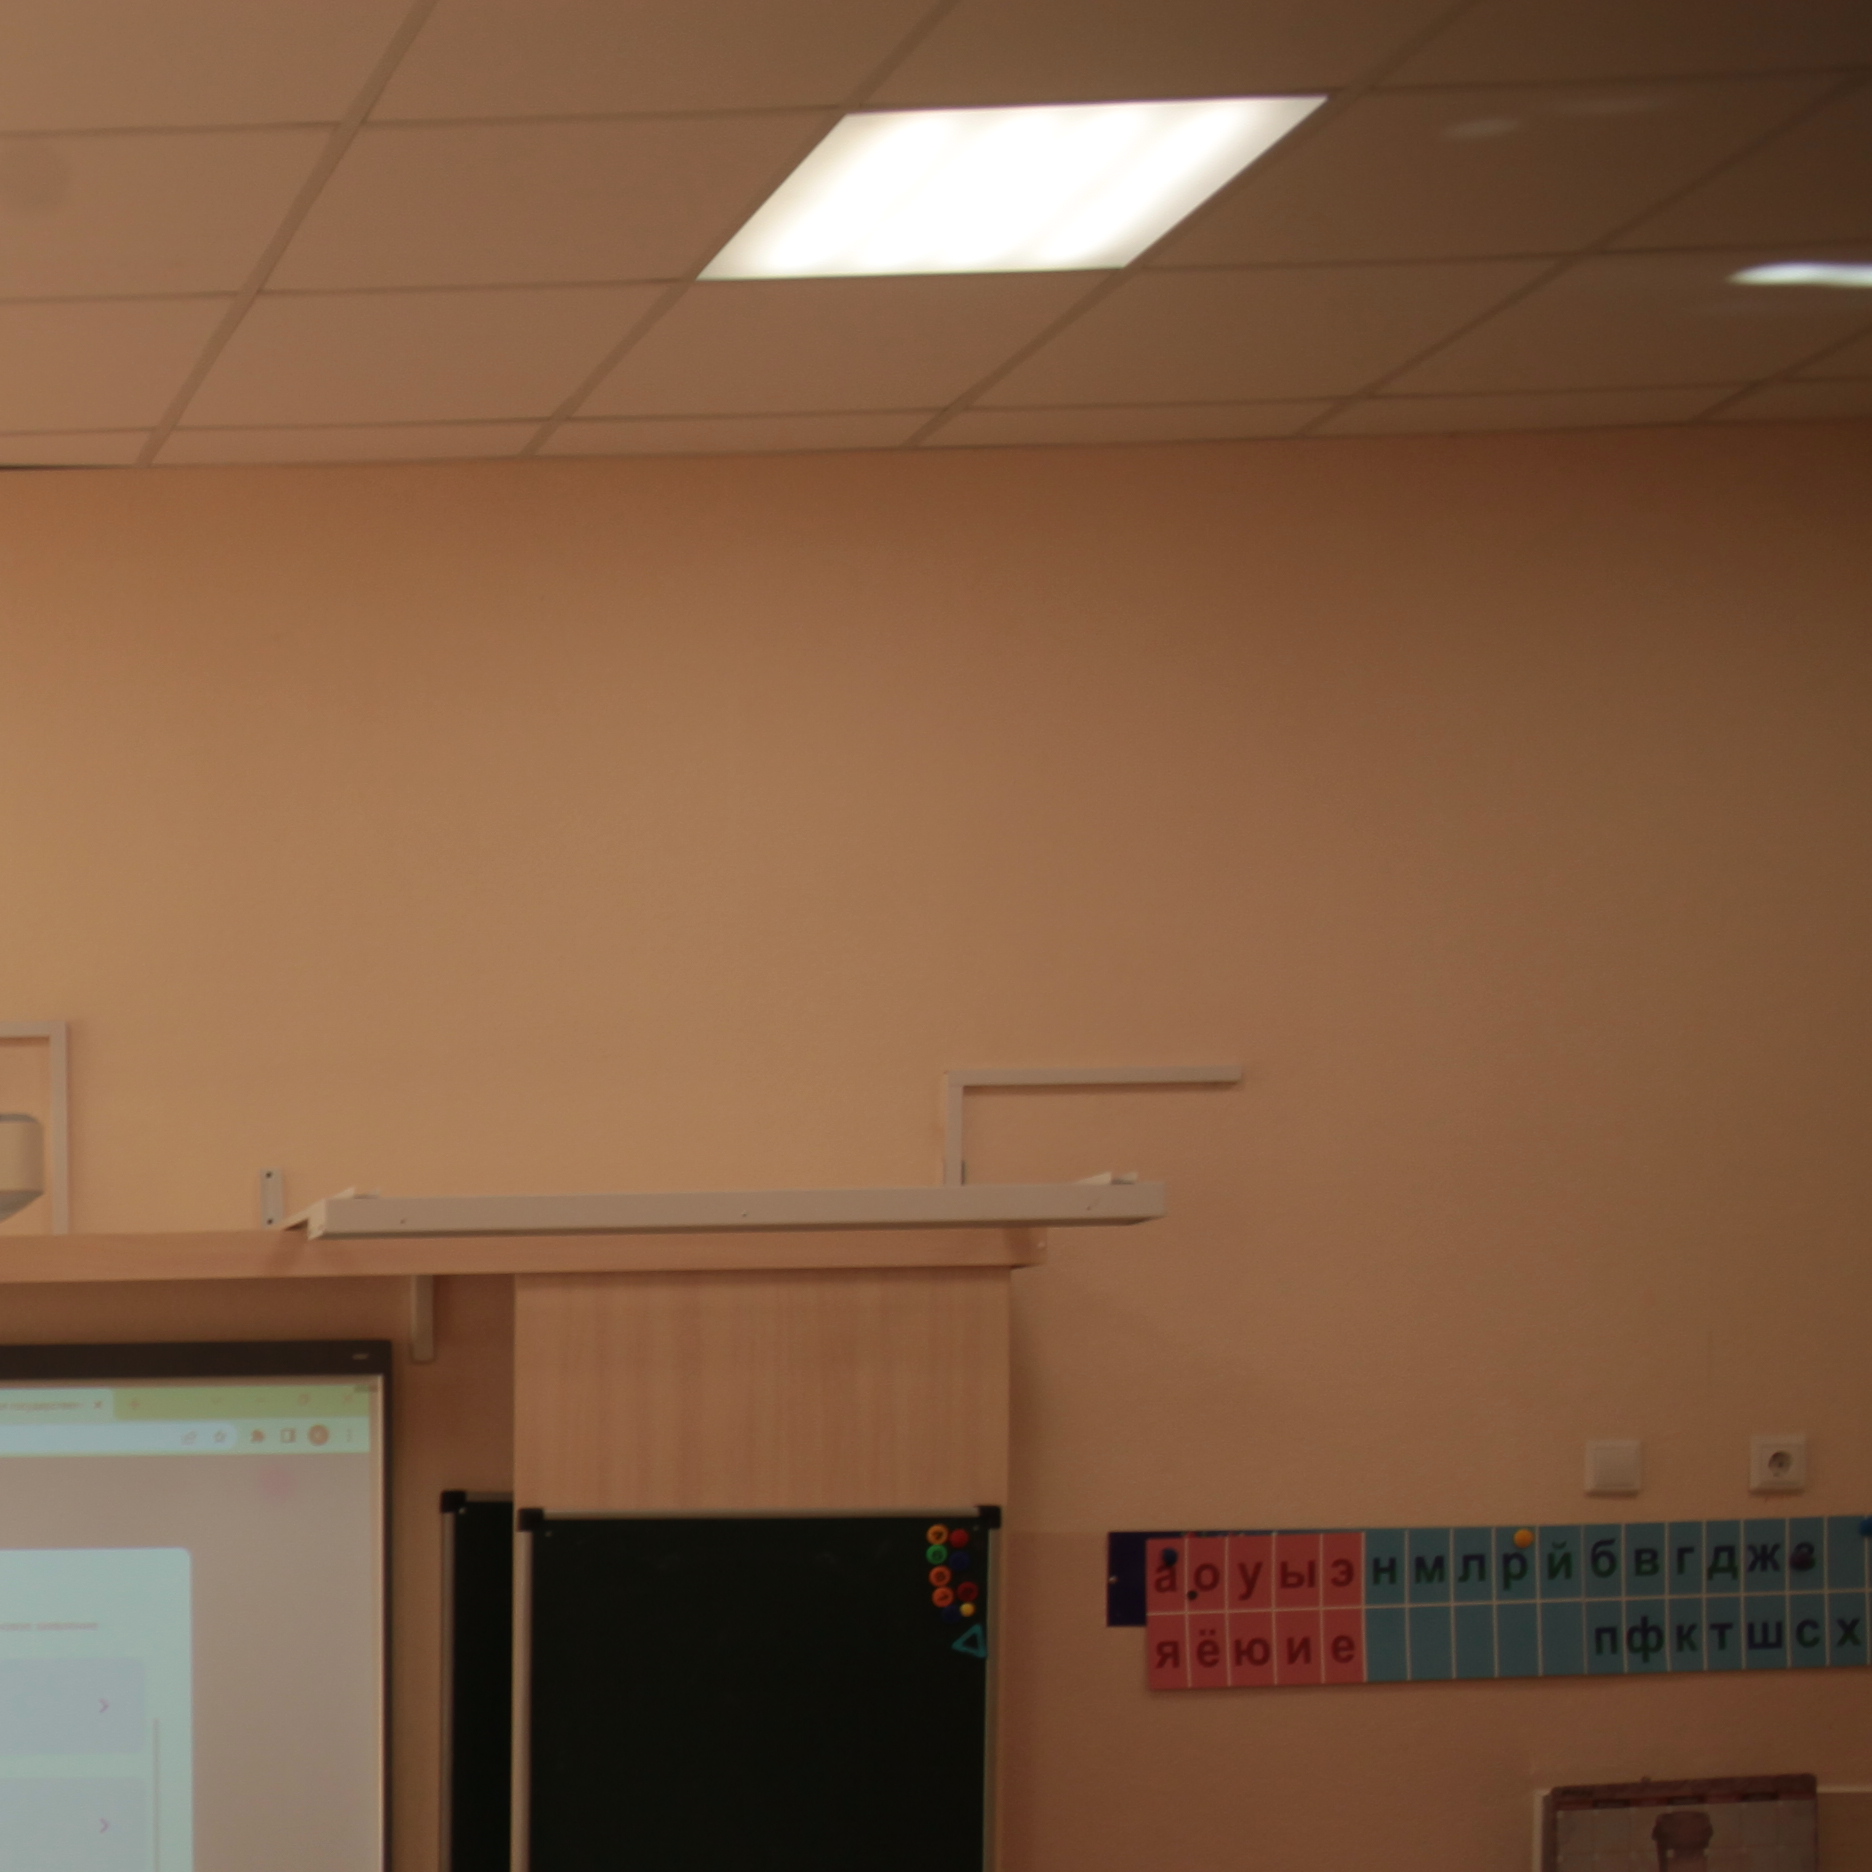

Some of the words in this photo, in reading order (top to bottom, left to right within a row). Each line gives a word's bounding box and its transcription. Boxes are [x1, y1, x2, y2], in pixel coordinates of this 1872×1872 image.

[1194, 1562, 1220, 1592] о
[1237, 1560, 1264, 1601] у
[1279, 1560, 1317, 1589] ы
[1330, 1558, 1355, 1587] э
[1372, 1557, 1397, 1585] н
[1414, 1555, 1445, 1584] м
[1457, 1553, 1487, 1582] л
[1502, 1552, 1529, 1591] р
[1547, 1540, 1573, 1580] й
[1590, 1538, 1617, 1578] б
[1634, 1547, 1660, 1577] в
[1676, 1546, 1695, 1575] г
[1706, 1545, 1739, 1580] д
[1746, 1543, 1781, 1573] ж
[1155, 1639, 1180, 1669] я
[1196, 1628, 1221, 1668] ё
[1233, 1637, 1270, 1667] ю
[1285, 1636, 1312, 1665] и
[1331, 1635, 1355, 1663] е
[1594, 1625, 1619, 1655] п
[1626, 1615, 1665, 1664] ф
[1675, 1623, 1698, 1653] к
[1709, 1622, 1734, 1651] т
[1747, 1620, 1783, 1650] ш
[1795, 1618, 1820, 1648] с
[1836, 1617, 1861, 1647] х
